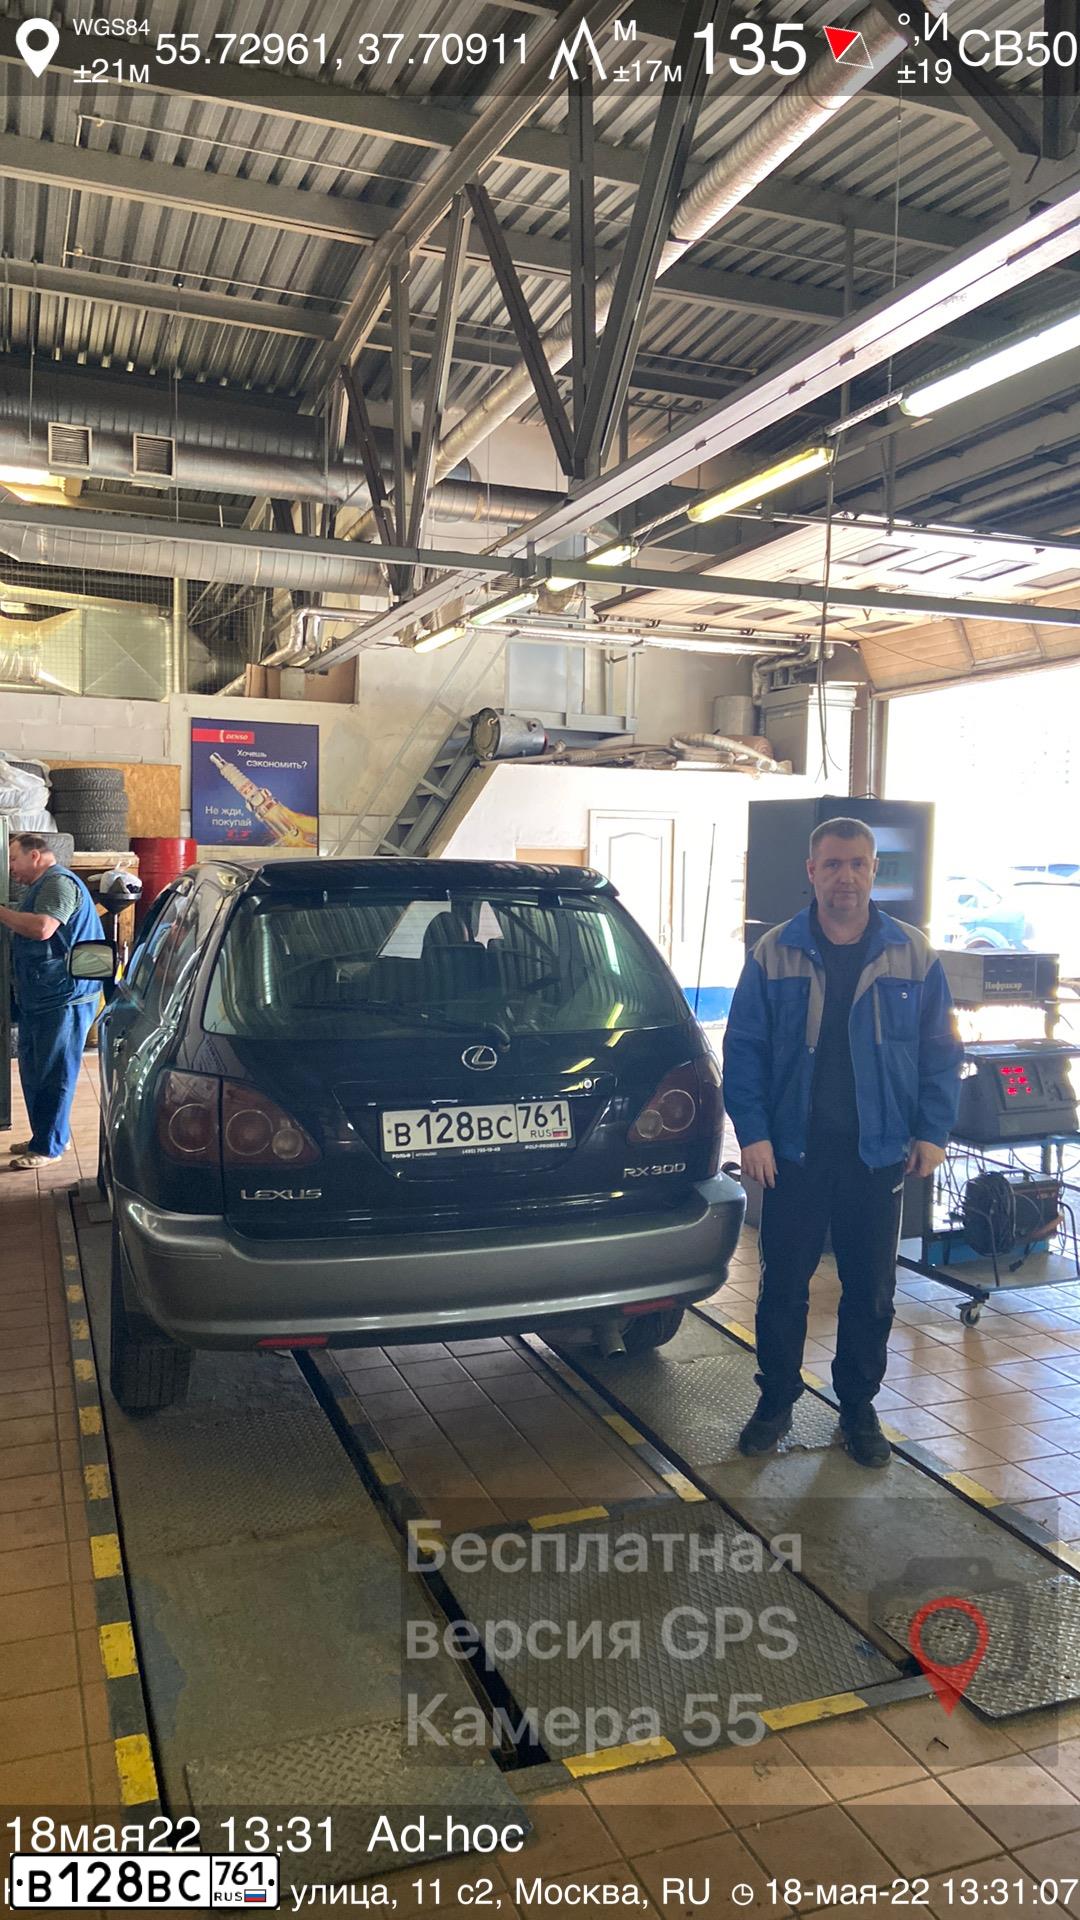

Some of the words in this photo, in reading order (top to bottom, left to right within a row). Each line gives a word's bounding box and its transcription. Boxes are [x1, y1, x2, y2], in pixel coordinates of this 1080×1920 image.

[246, 760, 308, 769] сэкономить?
[212, 818, 252, 828] покупай
[394, 1111, 513, 1147] В128ВС
[518, 1103, 565, 1129] 761
[530, 1129, 552, 1138] RUS
[240, 1189, 323, 1201] LEXUS
